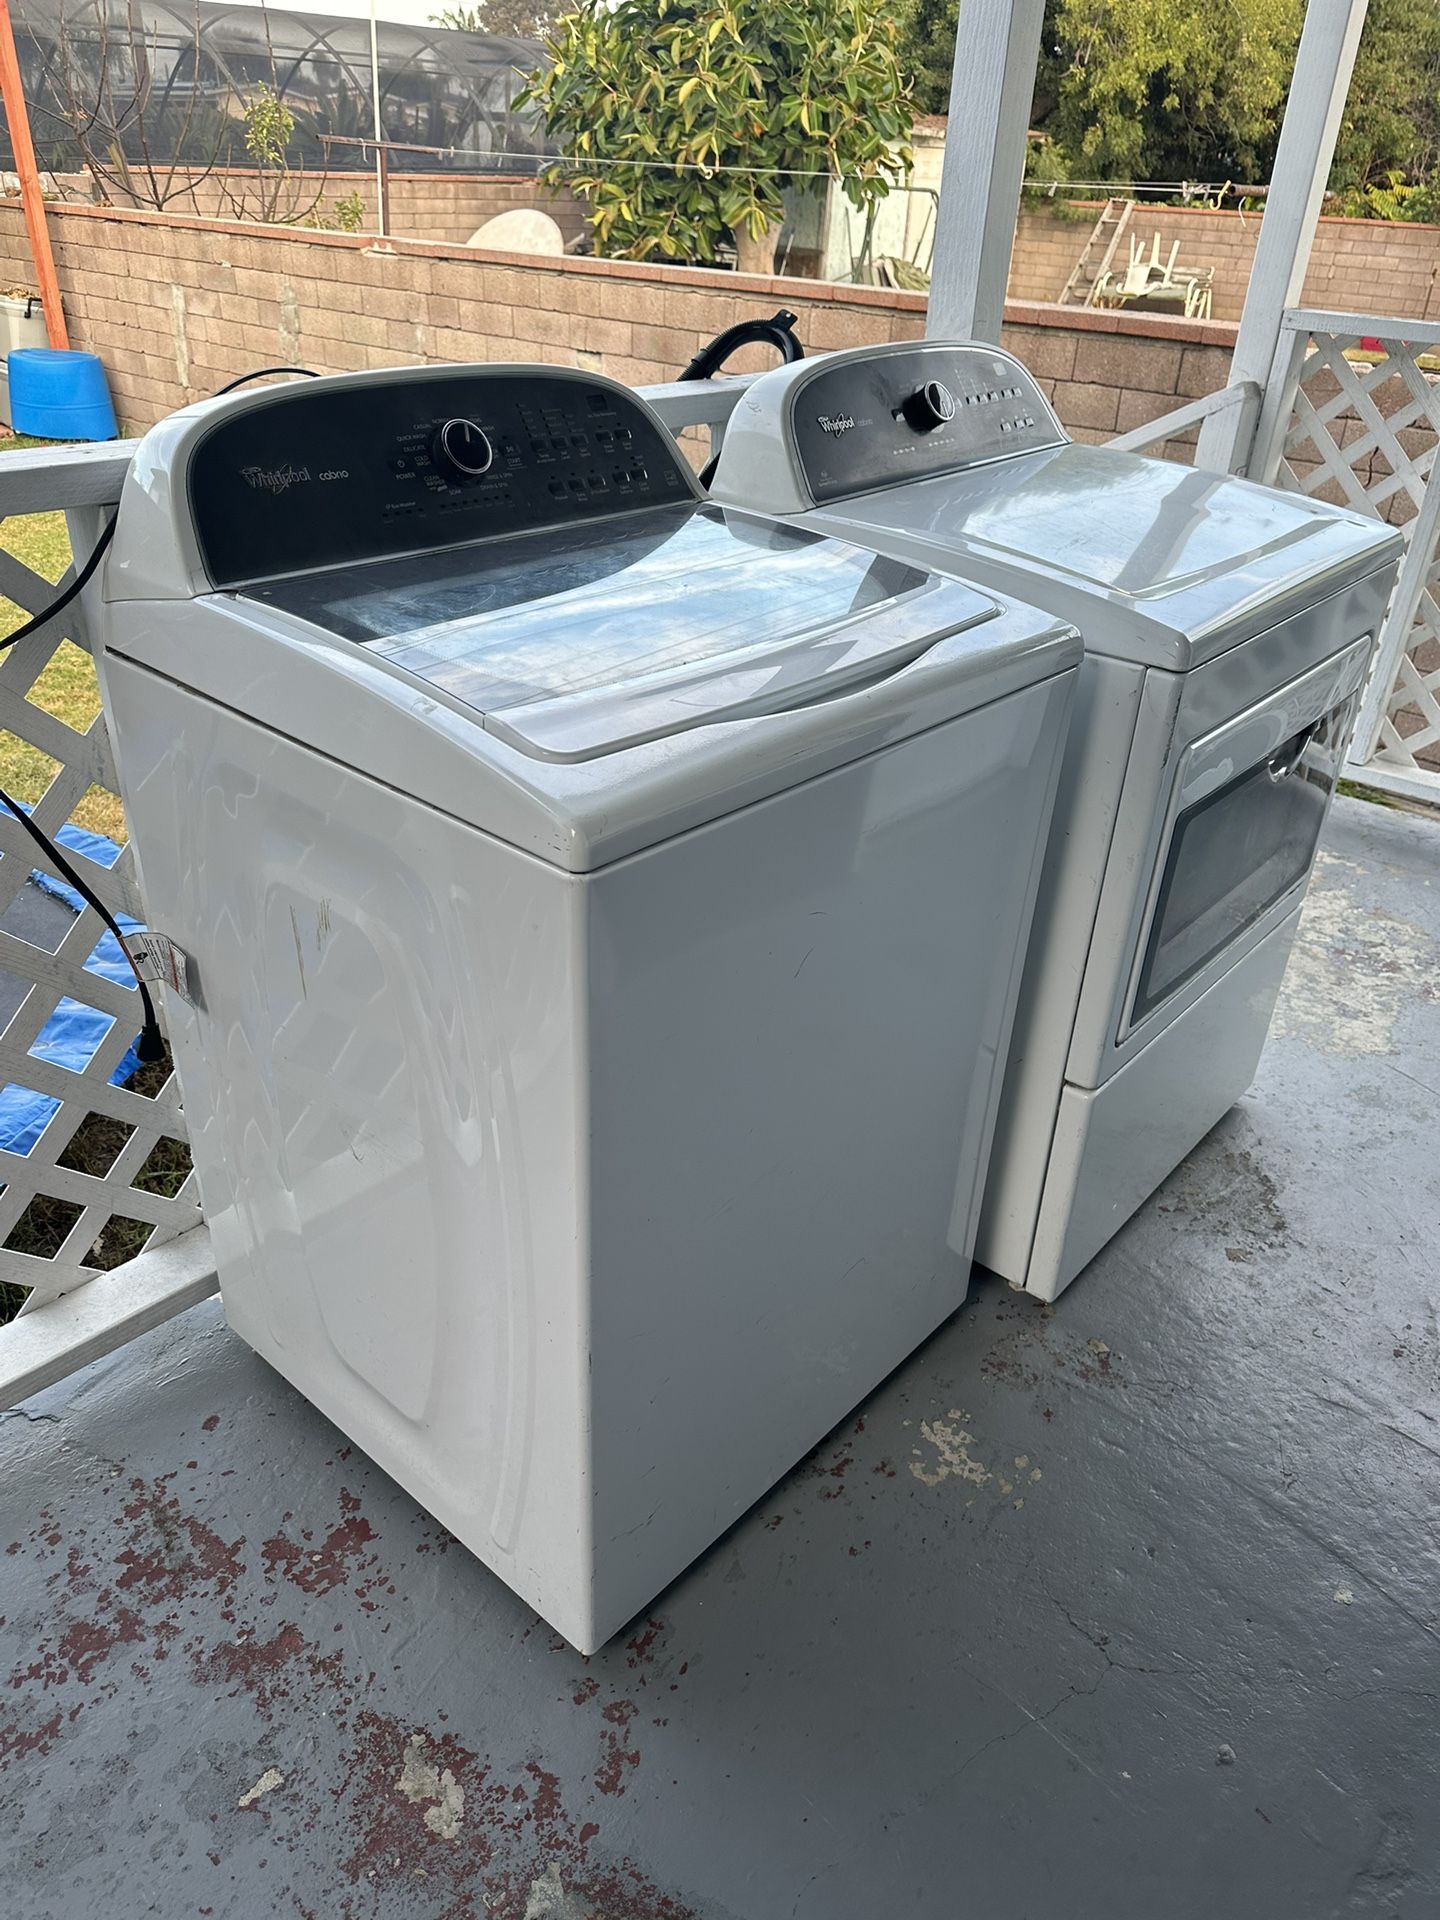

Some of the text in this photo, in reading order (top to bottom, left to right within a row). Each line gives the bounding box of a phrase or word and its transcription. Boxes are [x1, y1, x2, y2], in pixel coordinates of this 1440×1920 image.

[818, 413, 855, 438] Whirlpool
[241, 464, 311, 494] Whirlpool
[395, 471, 417, 481] POWER
